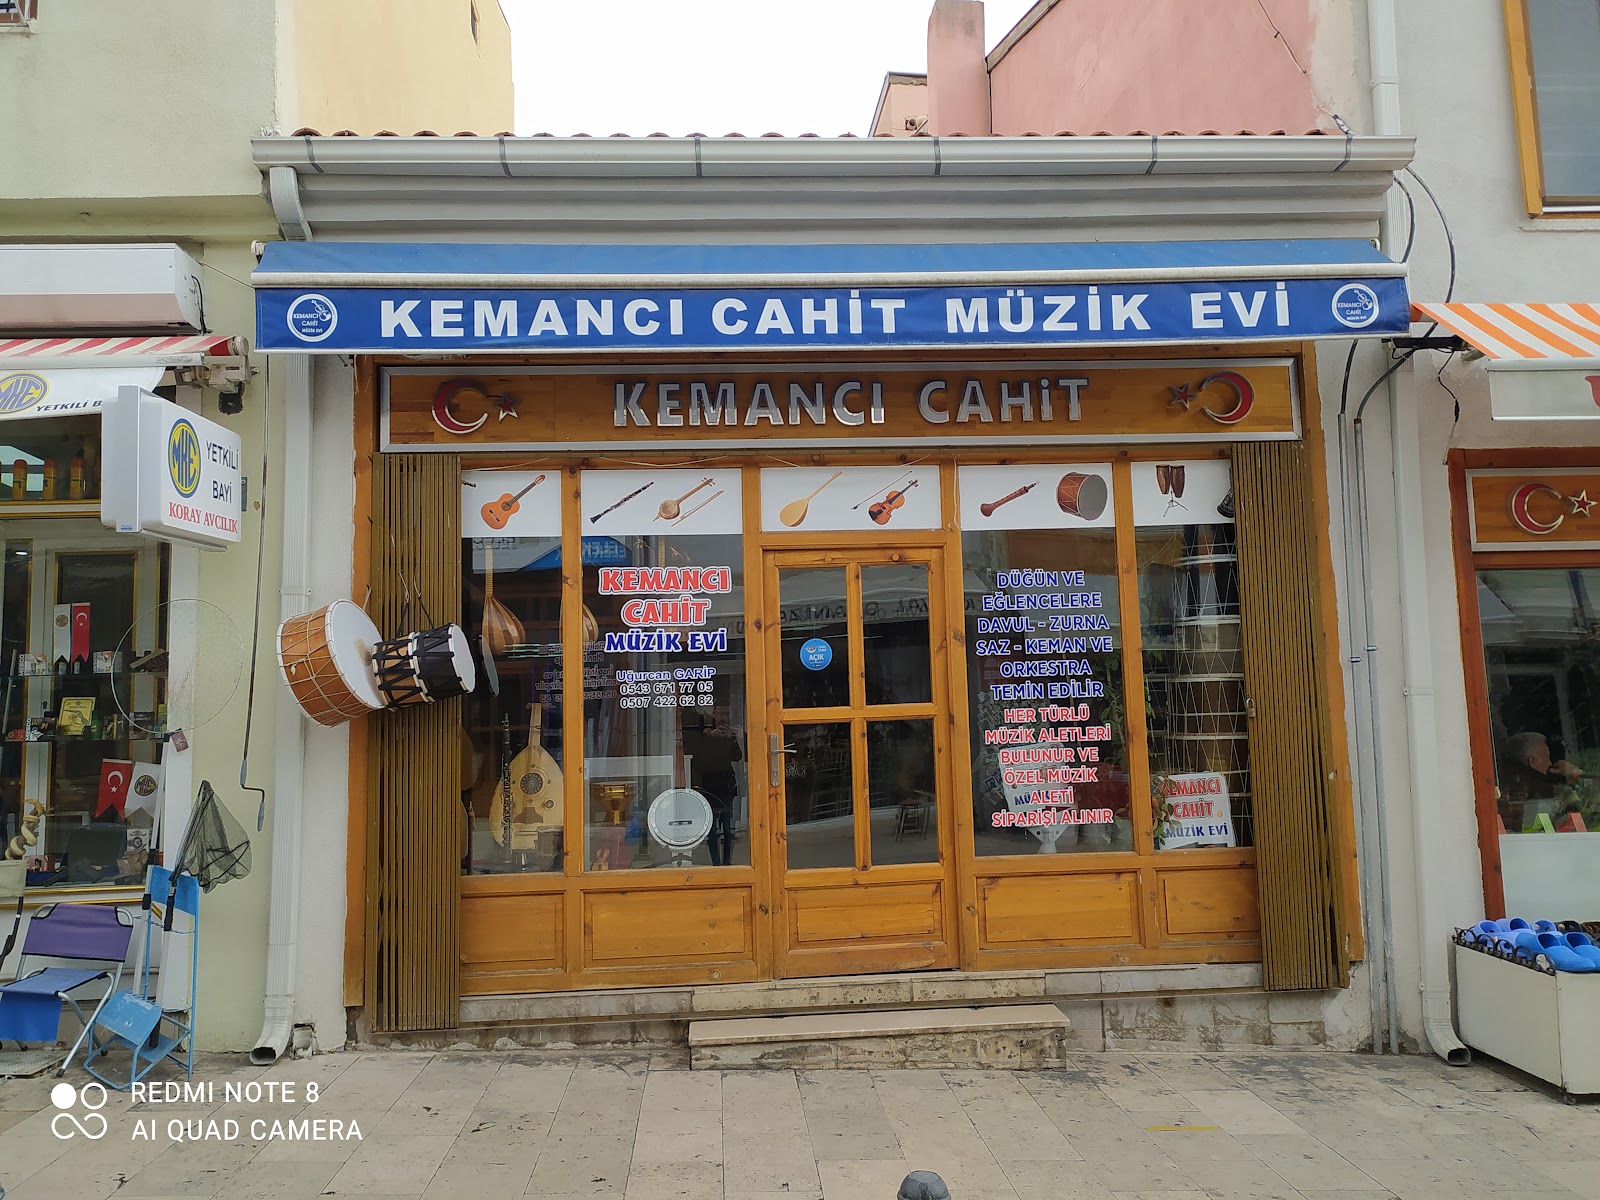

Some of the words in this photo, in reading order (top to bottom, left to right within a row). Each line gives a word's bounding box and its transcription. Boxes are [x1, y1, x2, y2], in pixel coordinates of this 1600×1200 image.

[380, 298, 683, 338] KEMANCI
[711, 289, 906, 335] CAHİT
[945, 286, 1151, 334] MÜZİK
[1190, 281, 1290, 329] EVİ
[37, 400, 88, 411] YETKİLİ
[613, 381, 885, 427] KEMANCI
[206, 440, 238, 470] YETKİLİ
[212, 480, 232, 503] BAYİ
[169, 501, 201, 524] KORAY
[203, 511, 238, 533] AVCILIK
[600, 567, 730, 593] KEMANCI
[997, 569, 1059, 588] DÜĞÜN
[1061, 571, 1085, 586] VE
[622, 596, 710, 625] CAHİT
[982, 592, 1102, 611] EĞLENCELERE
[978, 617, 1035, 633] DAVUL
[1049, 614, 1110, 631] ZURNA
[605, 629, 681, 652] MÜZİK
[688, 628, 726, 651] EVİ
[976, 639, 1011, 656] SAZ
[1025, 638, 1087, 654] KEMAN
[1090, 637, 1114, 652] VE
[808, 654, 824, 662] AÇIK
[616, 670, 671, 683] Uğurcan
[674, 665, 716, 679] GARİP
[1000, 660, 1092, 678] ORKESTRA
[620, 683, 651, 695] 0543
[653, 682, 675, 693] 671
[679, 681, 695, 693] 77
[697, 681, 714, 692] 05
[991, 680, 1043, 700] TEMİN
[1048, 679, 1104, 698] EDİLİR
[620, 697, 651, 708] 0507
[653, 696, 677, 707] 422
[680, 695, 696, 706] 62
[698, 694, 714, 706] 82
[1004, 708, 1036, 723] HER
[1039, 704, 1090, 722] TÜRLÜ
[985, 726, 1035, 744] MÜZİK
[1038, 723, 1111, 741] ALETLERİ
[1001, 748, 1075, 764] BULUNUR
[1077, 747, 1100, 761] VE
[1003, 767, 1044, 785] ÖZEL
[1047, 765, 1099, 783] MÜZİK
[1030, 786, 1075, 804] ALETİ
[991, 809, 1056, 827] SİPARİŞİ
[1061, 809, 1114, 824] ALINIR
[1173, 798, 1215, 819] CAHİT
[1208, 822, 1229, 836] EVİ
